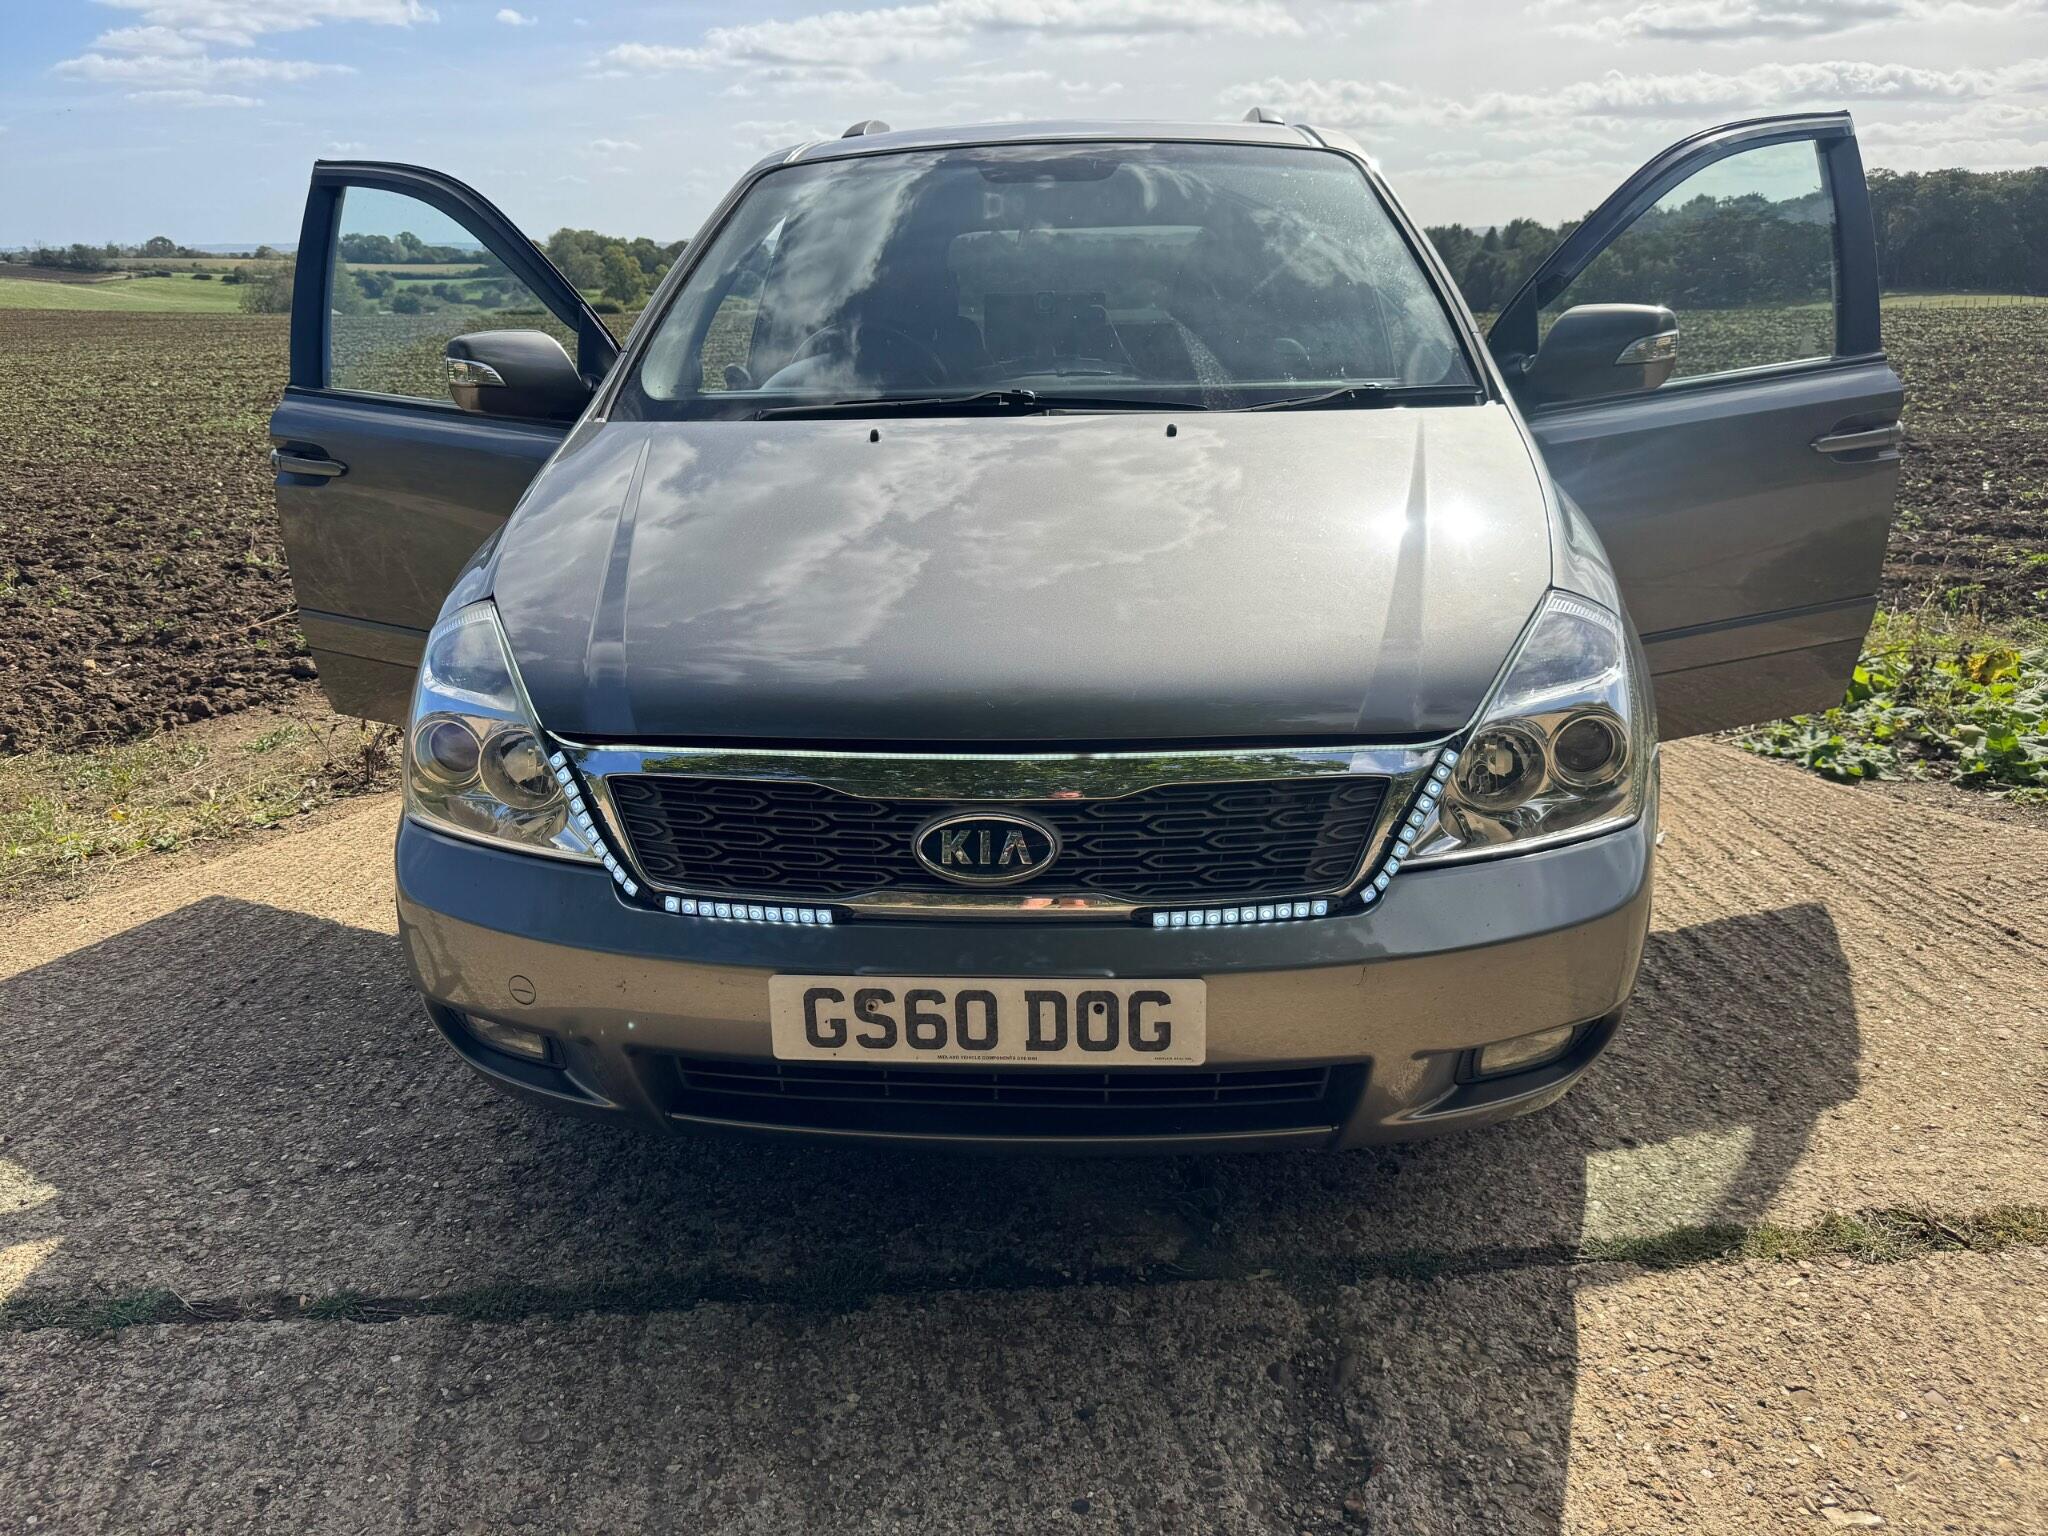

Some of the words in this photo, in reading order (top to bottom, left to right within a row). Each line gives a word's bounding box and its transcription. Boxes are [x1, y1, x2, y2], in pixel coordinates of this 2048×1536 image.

[940, 830, 1032, 864] KIA
[803, 987, 998, 1050] GS60
[1024, 990, 1172, 1052] DOG
